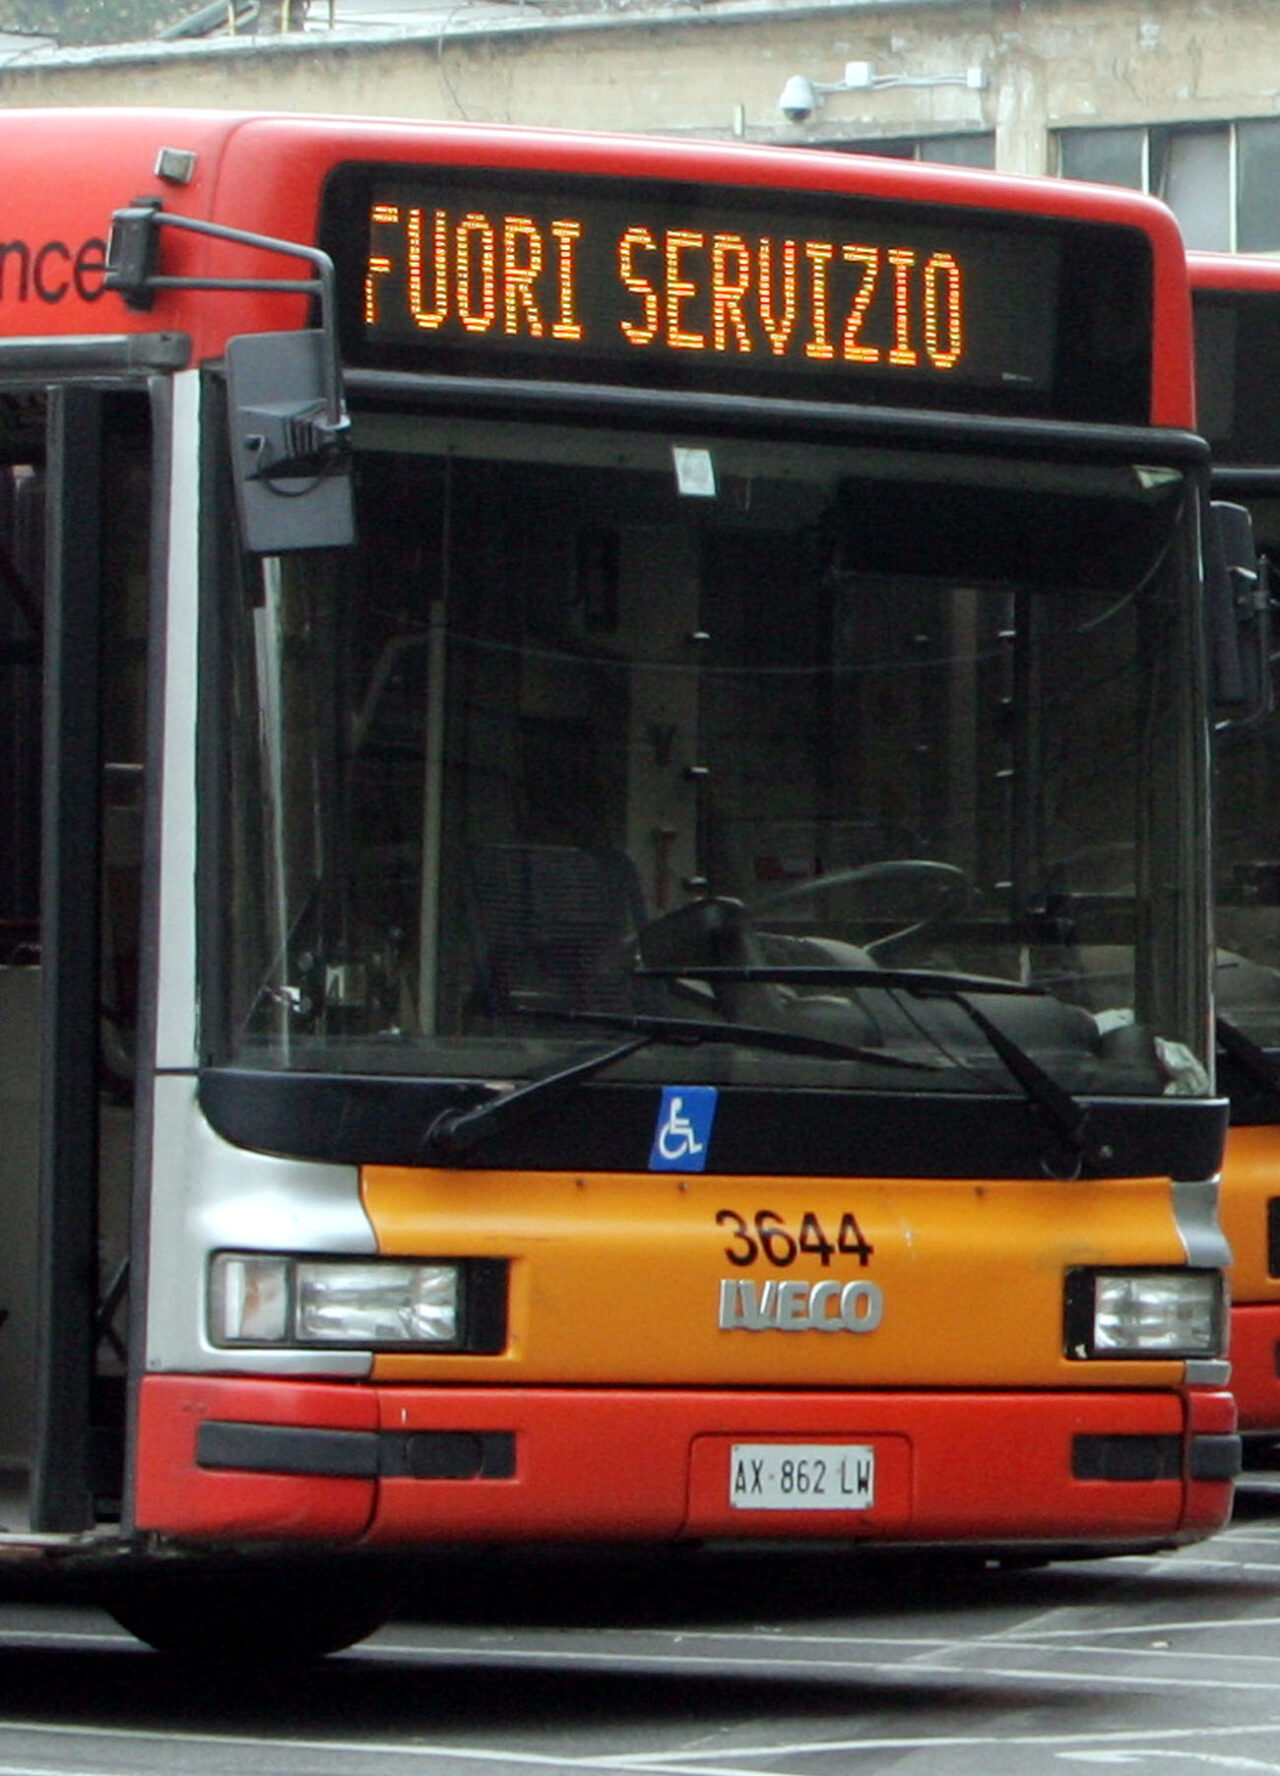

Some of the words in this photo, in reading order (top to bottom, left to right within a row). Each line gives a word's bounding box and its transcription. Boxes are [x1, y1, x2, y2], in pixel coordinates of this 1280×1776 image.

[364, 203, 582, 341] FUORI
[618, 226, 963, 370] SERVIZIO
[715, 1209, 875, 1267] 3644
[719, 1278, 884, 1333] IVECO
[735, 1459, 764, 1495] AX
[780, 1459, 827, 1495] 862
[841, 1459, 871, 1495] LW
